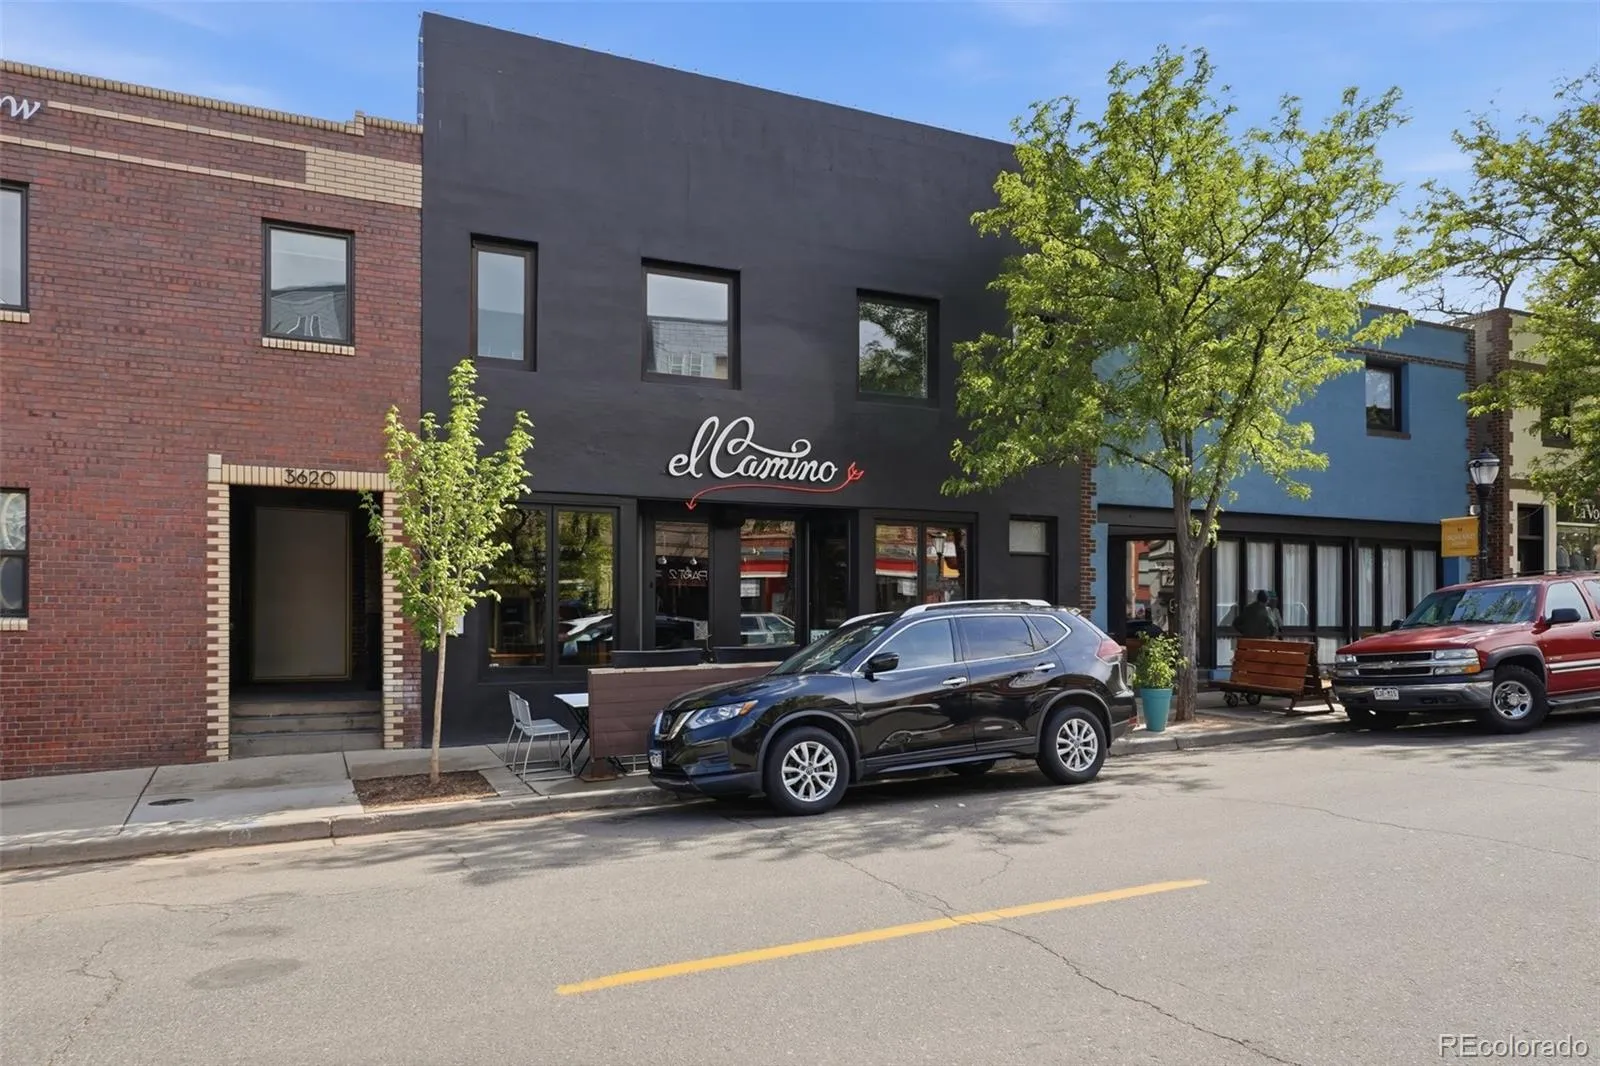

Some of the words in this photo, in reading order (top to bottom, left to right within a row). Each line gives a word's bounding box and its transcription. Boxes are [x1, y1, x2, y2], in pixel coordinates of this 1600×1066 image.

[668, 415, 719, 479] el
[709, 415, 838, 483] Camino
[284, 469, 336, 485] 3620
